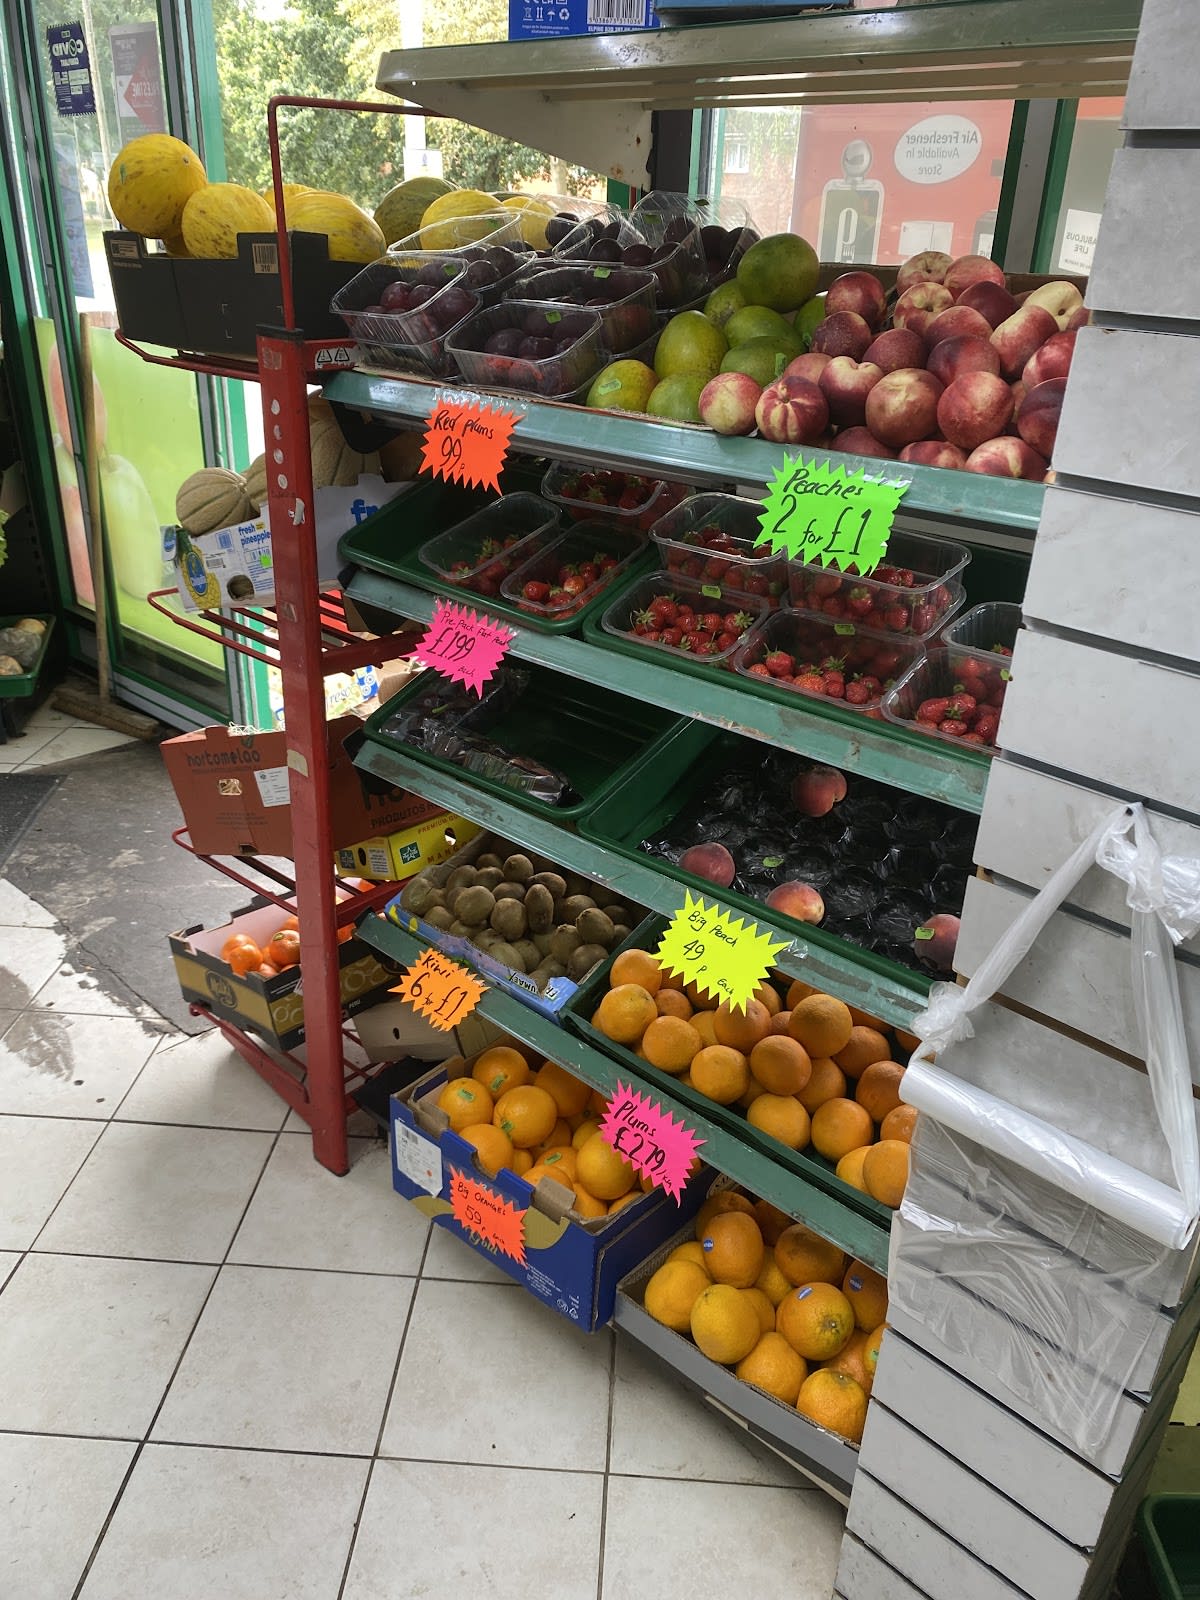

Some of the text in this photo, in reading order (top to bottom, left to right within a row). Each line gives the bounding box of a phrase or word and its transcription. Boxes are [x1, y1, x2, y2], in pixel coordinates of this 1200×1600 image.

[434, 410, 463, 431] Red
[783, 468, 864, 499] Peaches
[238, 522, 256, 537] fresh
[772, 494, 873, 555] 2 for £1
[687, 910, 738, 948] Big Peach
[683, 939, 705, 961] 49
[410, 972, 431, 998] 6
[434, 986, 469, 1022] £1
[613, 1100, 657, 1137] Plums
